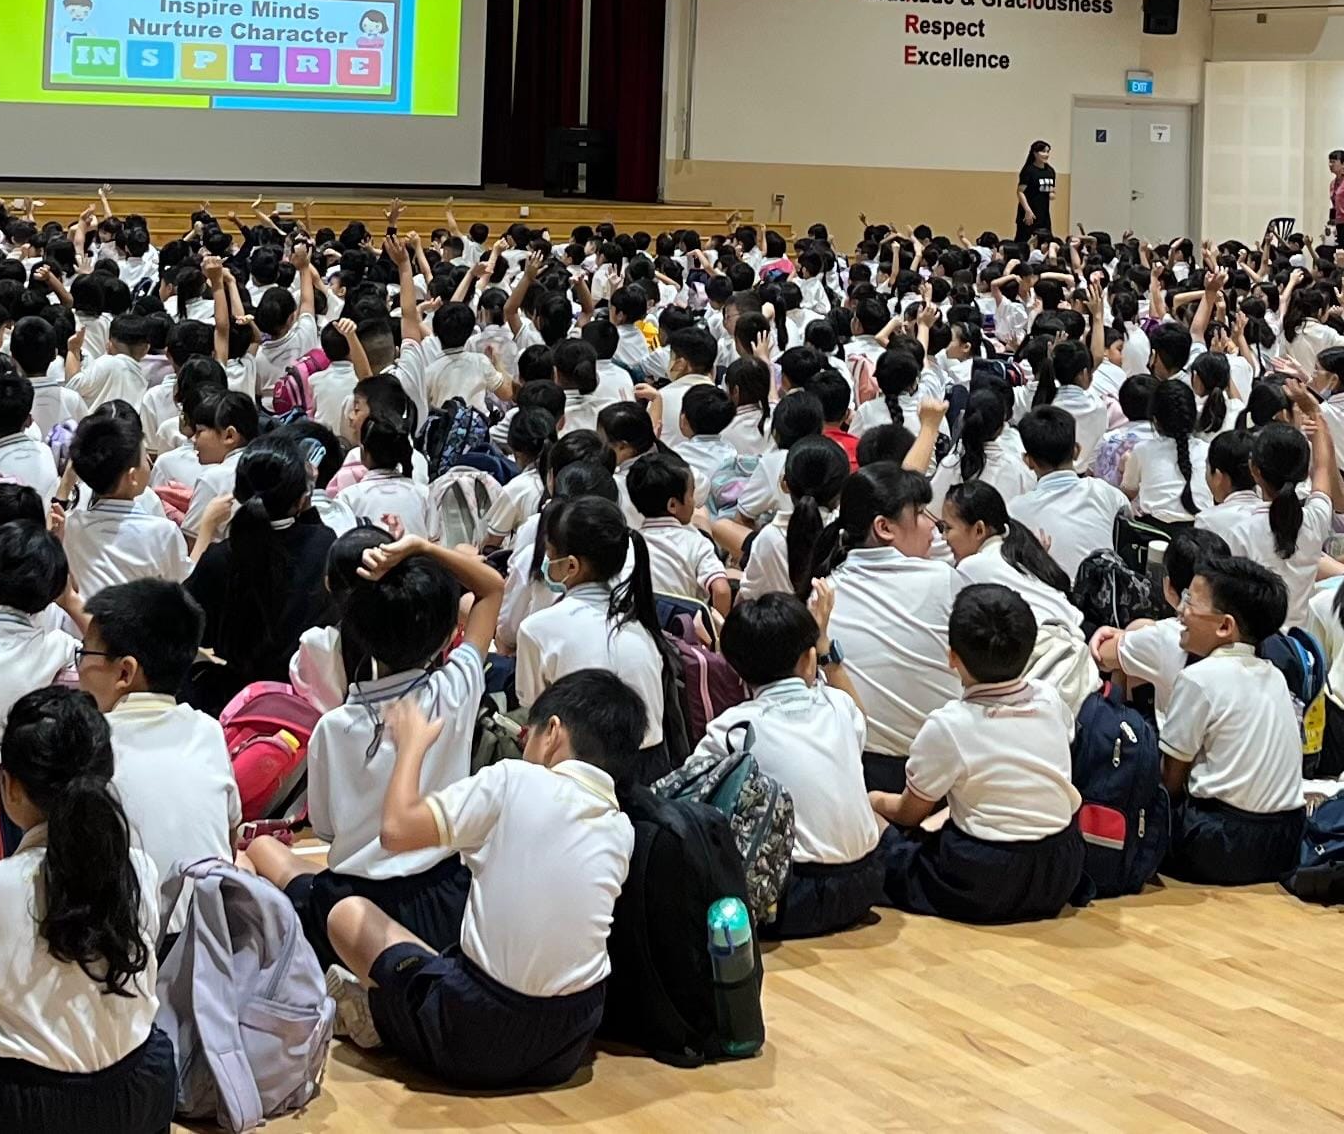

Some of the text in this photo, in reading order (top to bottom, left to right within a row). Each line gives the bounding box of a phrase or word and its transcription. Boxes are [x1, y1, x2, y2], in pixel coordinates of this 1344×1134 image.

[251, 0, 320, 20] Minds
[127, 17, 349, 44] Nurture Character
[906, 15, 985, 40] Respect
[75, 45, 370, 76] IN S P I R E
[905, 46, 1009, 69] Excellence
[1132, 81, 1148, 92] EXIT
